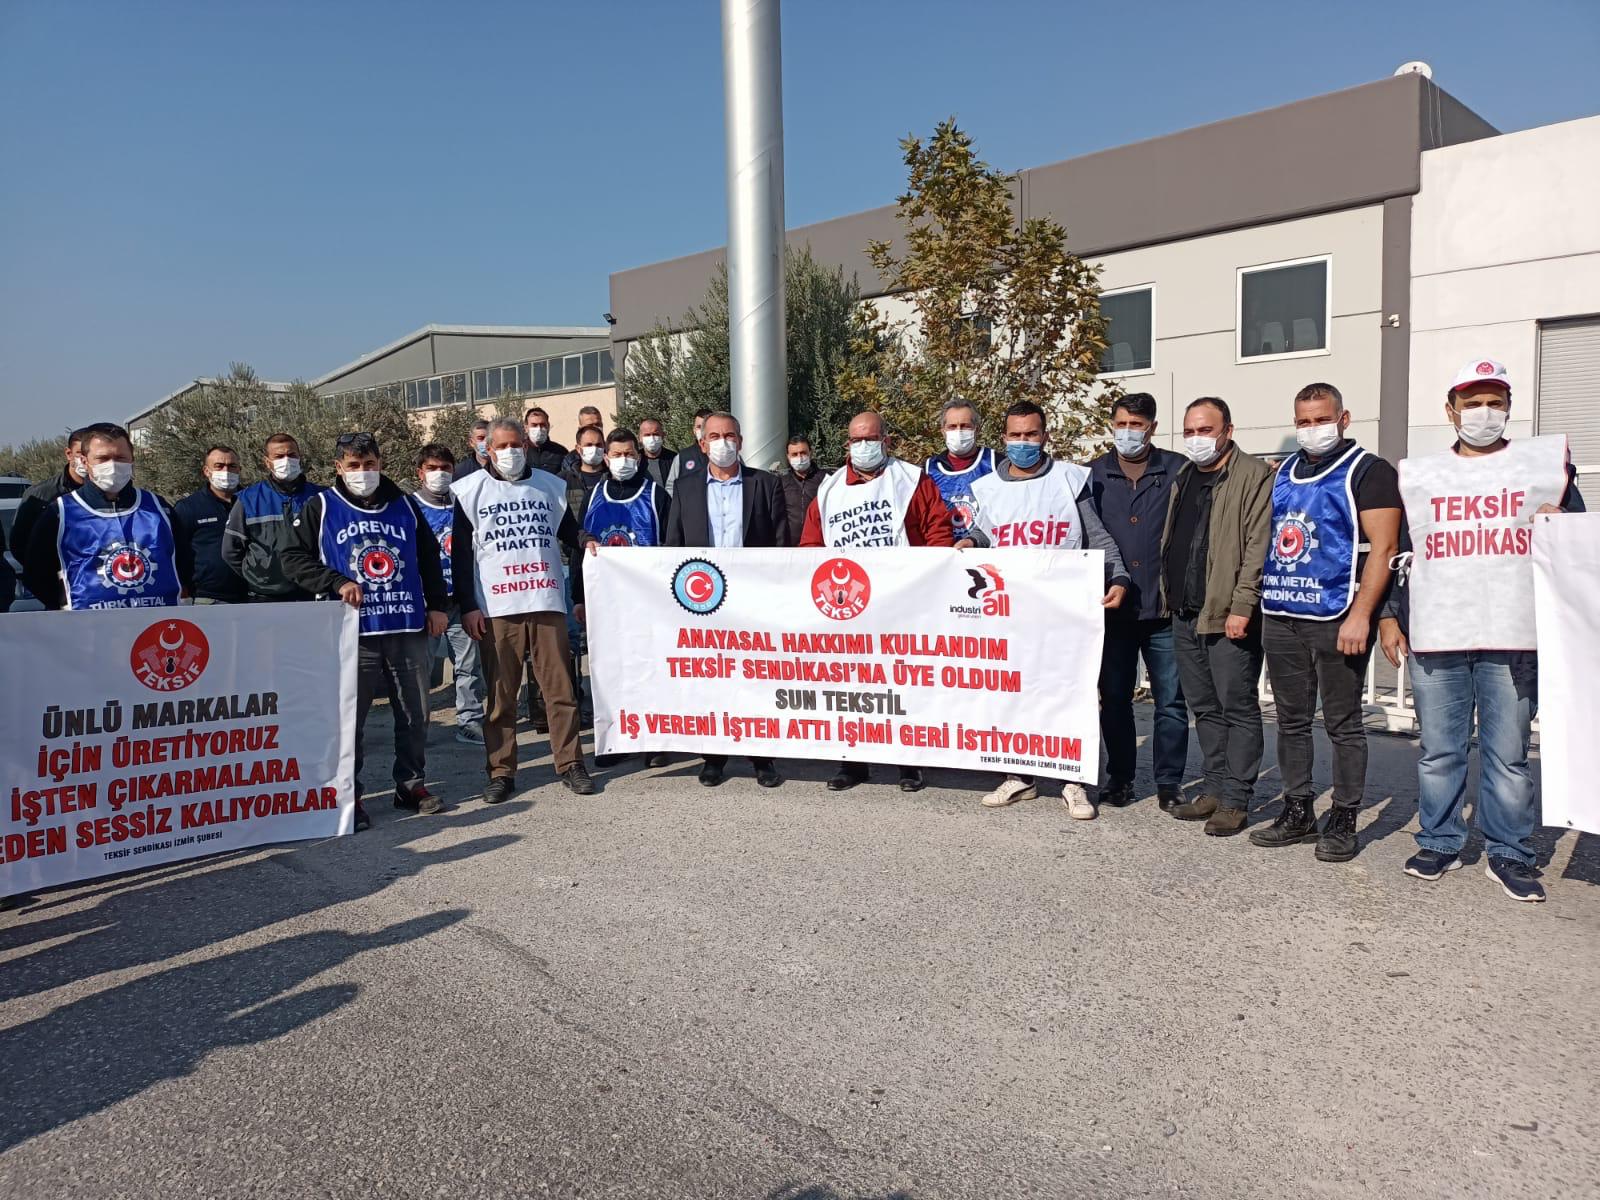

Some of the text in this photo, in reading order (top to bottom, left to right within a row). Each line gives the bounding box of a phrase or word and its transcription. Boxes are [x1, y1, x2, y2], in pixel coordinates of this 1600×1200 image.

[478, 498, 553, 519] SENDİKAL
[829, 499, 892, 528] SENDİKA
[1430, 488, 1525, 522] TEKSİF
[495, 512, 549, 526] OLMAK
[841, 511, 893, 533] OLMAK
[991, 514, 1070, 547] EKSİF
[484, 525, 554, 541] ANAYASA
[833, 524, 893, 547] ANAYAS
[1425, 522, 1532, 561] SENDİKASI
[495, 538, 552, 552] HAKTIR
[503, 560, 550, 577] TEKSİF
[492, 577, 560, 595] SENDİKAS
[1281, 575, 1323, 590] METAL
[130, 596, 166, 608] METAL
[360, 604, 414, 616] ENDİKAS
[363, 594, 380, 604] RK
[949, 604, 981, 614] industri
[677, 628, 1008, 661] ANAYASAL HAKKIMI KULLANDIM
[666, 653, 736, 678] TEKSİF
[893, 659, 934, 687] ÜYE
[941, 666, 1022, 693] OLDUM
[775, 688, 907, 716] SUN TEKSTİL
[42, 691, 279, 739] ÜNLÜ MARKALAR
[620, 709, 1082, 762] İŞ VERENİ İŞTEN ATTI İŞİMİ GERİ İSTİYORUM
[37, 725, 280, 783] İÇİN ÜRETİYORUZ
[980, 755, 1002, 764] TEKSİF
[1003, 757, 1036, 767] SENDİKASI
[1038, 760, 1057, 769] İZMİR
[11, 757, 301, 827] İŞTEN ÇIKARMALARA
[76, 804, 173, 850] SESSİZ
[181, 786, 338, 830] KALIYORLAR
[104, 829, 223, 861] TEKSİF SENDİKASI İZMİR ŞUBESİ
